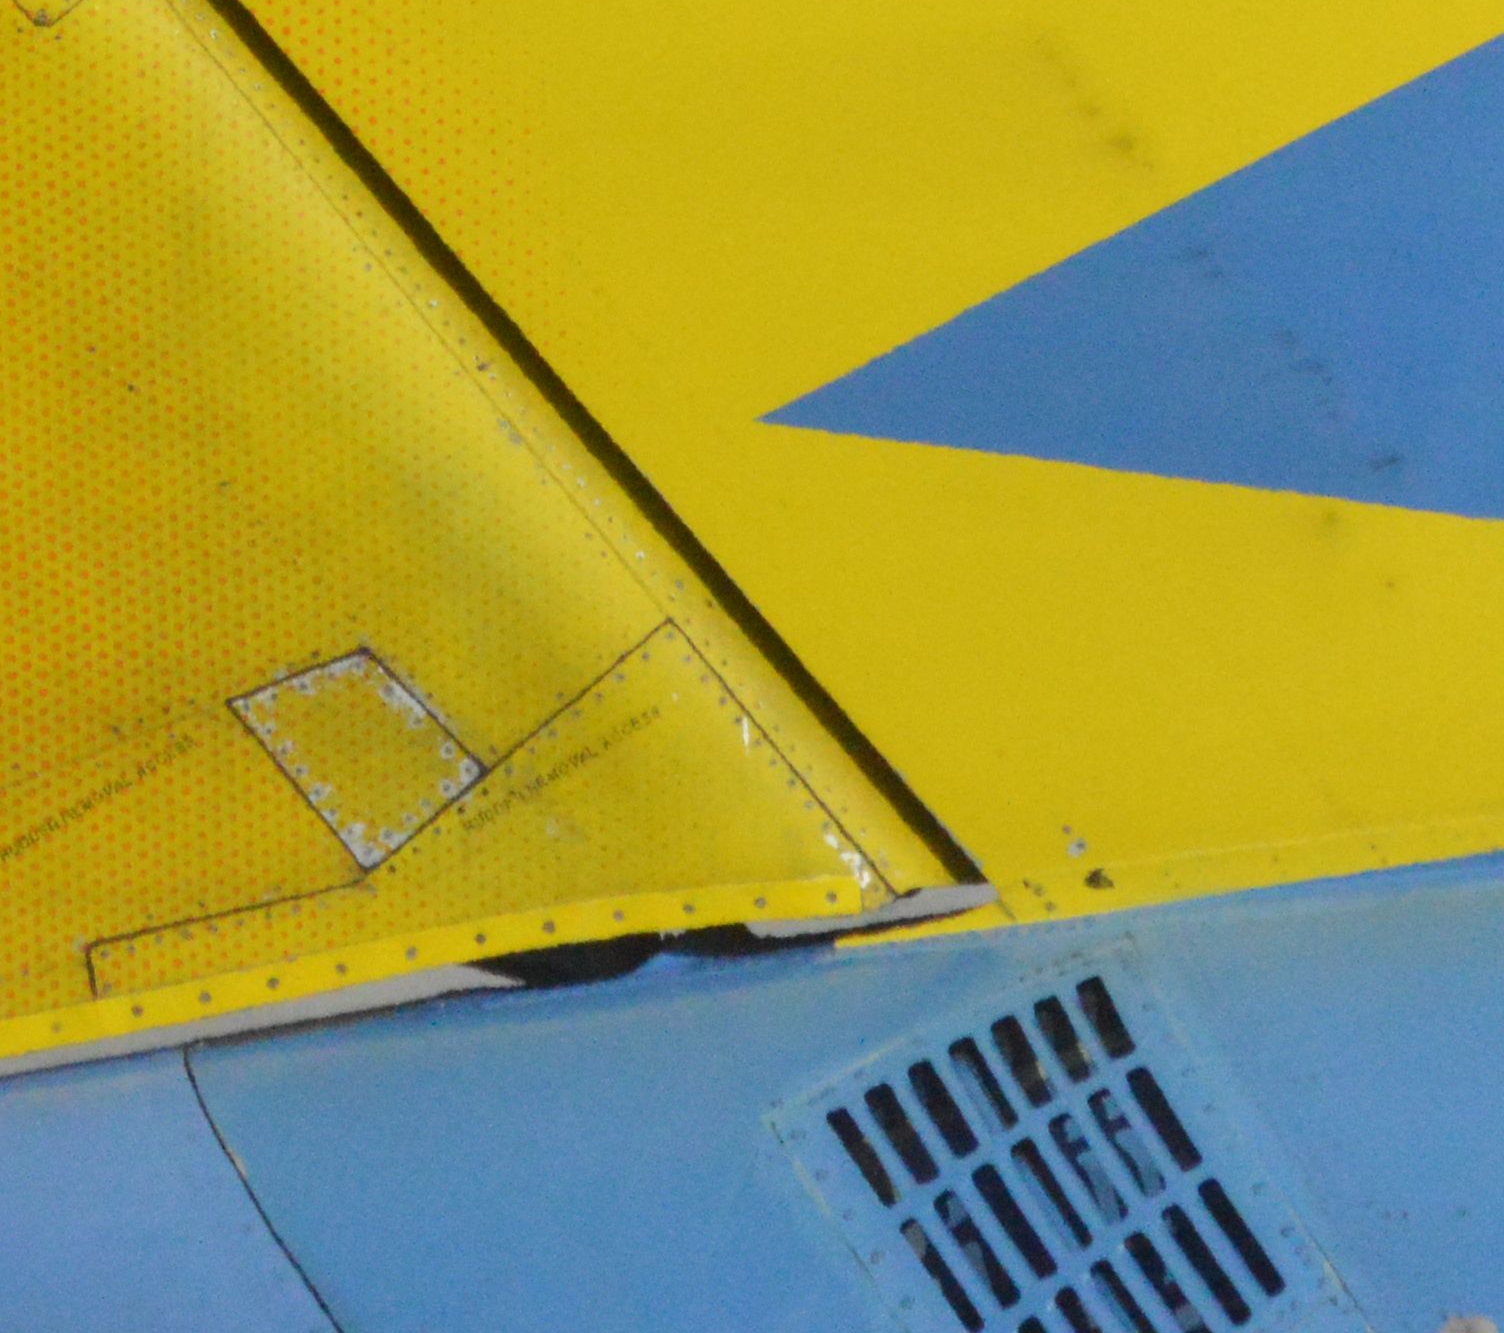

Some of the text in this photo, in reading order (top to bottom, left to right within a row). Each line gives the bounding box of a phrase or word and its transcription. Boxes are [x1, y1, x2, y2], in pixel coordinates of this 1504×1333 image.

[527, 746, 599, 792] REMOVAL
[603, 705, 662, 750] ACCESS
[61, 772, 133, 824] REMOVAL
